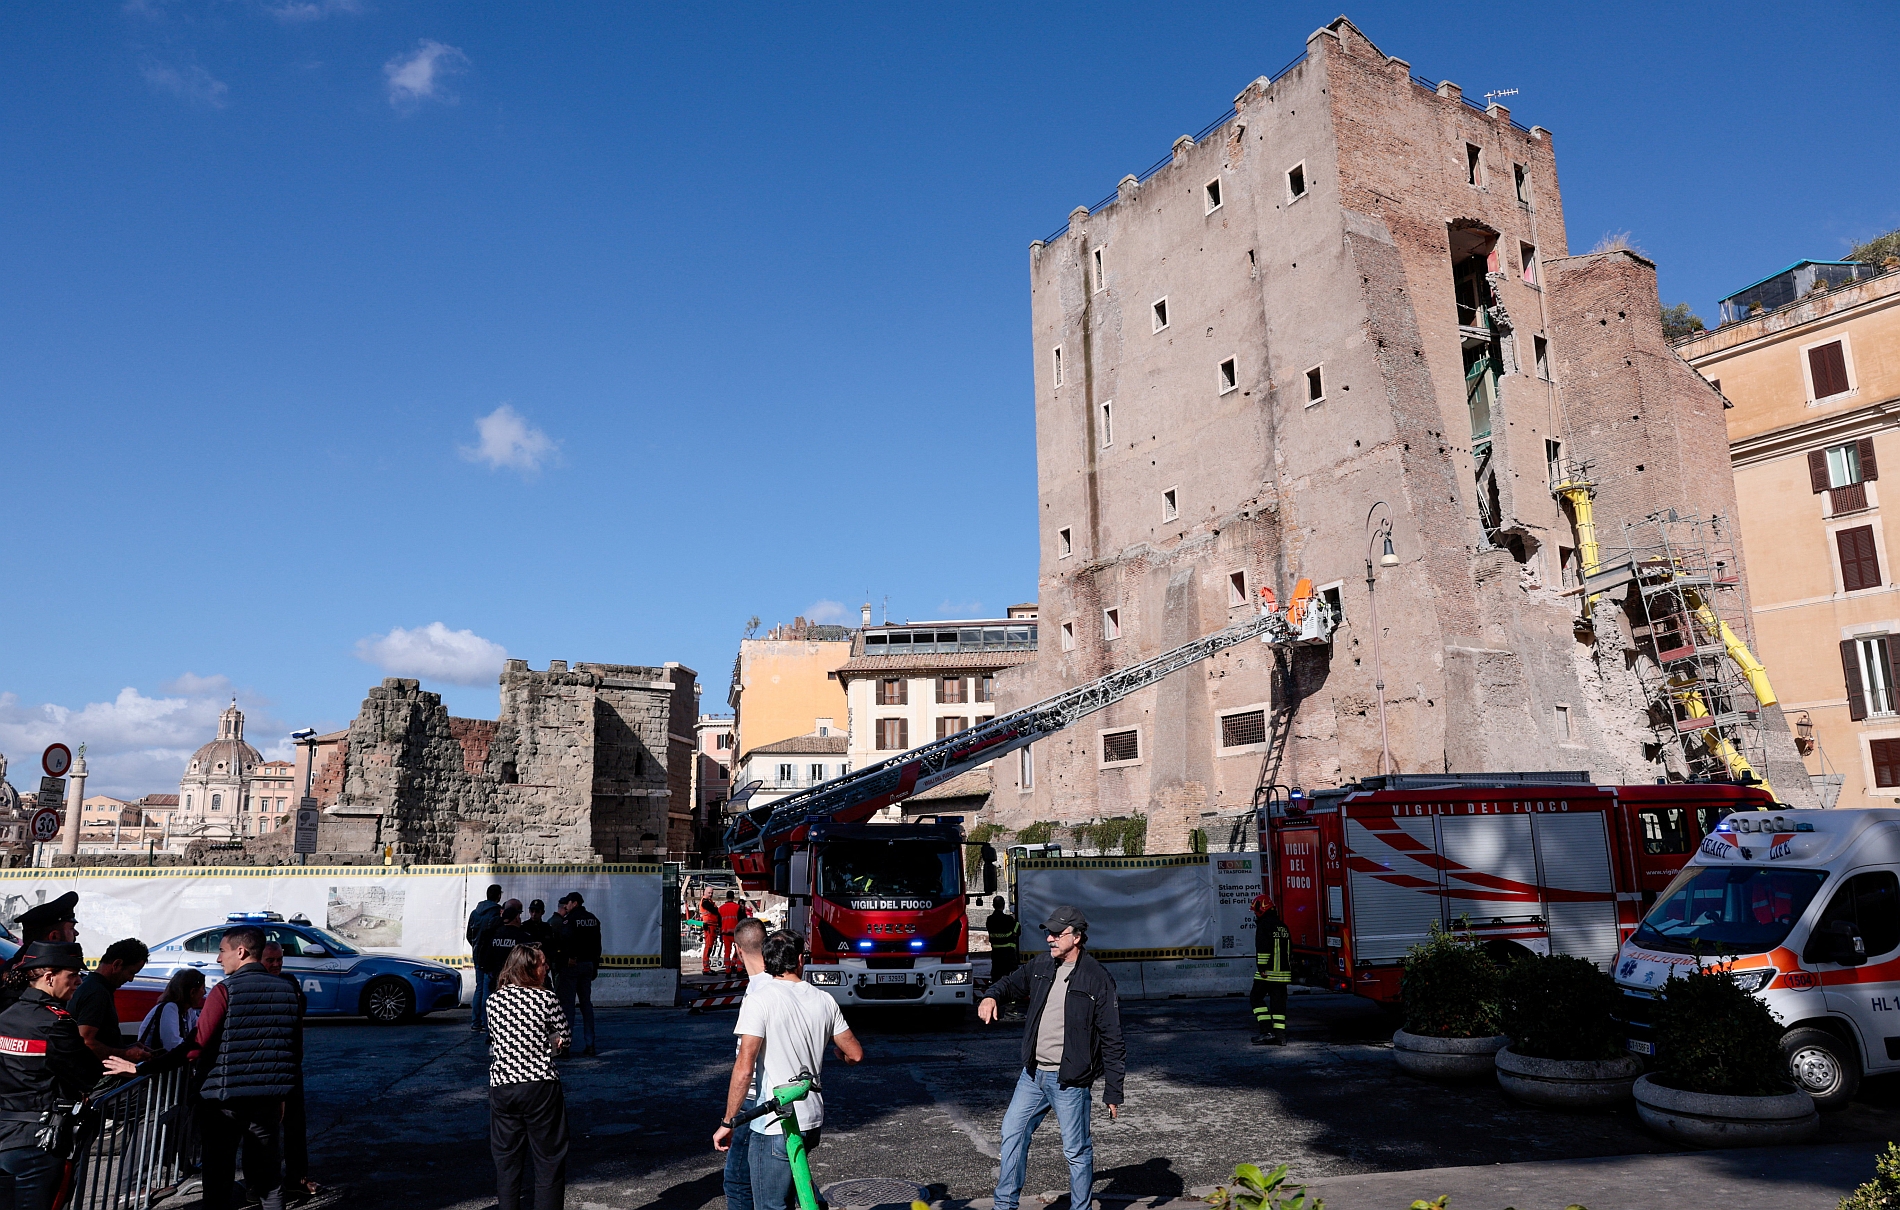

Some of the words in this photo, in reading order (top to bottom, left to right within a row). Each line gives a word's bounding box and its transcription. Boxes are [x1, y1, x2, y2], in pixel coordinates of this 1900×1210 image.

[1392, 803, 1454, 816] VIGILI
[1467, 802, 1501, 814] DEL
[1513, 800, 1568, 813] FUOCO
[38, 817, 54, 833] 30
[1285, 842, 1309, 856] VIGILI
[1700, 837, 1732, 859] HEART
[1770, 839, 1791, 860] LIFE
[1218, 861, 1252, 869] ROMA
[1290, 859, 1305, 872] DEL
[1327, 861, 1340, 869] 115
[1245, 884, 1261, 892] port
[1286, 876, 1311, 889] FUOCO
[851, 900, 878, 910] VIGILI
[880, 900, 898, 910] DEL
[900, 900, 933, 909] FUOCO
[576, 918, 598, 928] POLIZIA
[866, 923, 917, 934] IVECO
[492, 938, 516, 948] POLIZIA
[1788, 974, 1812, 987] 1504
[1871, 997, 1892, 1012] HL
